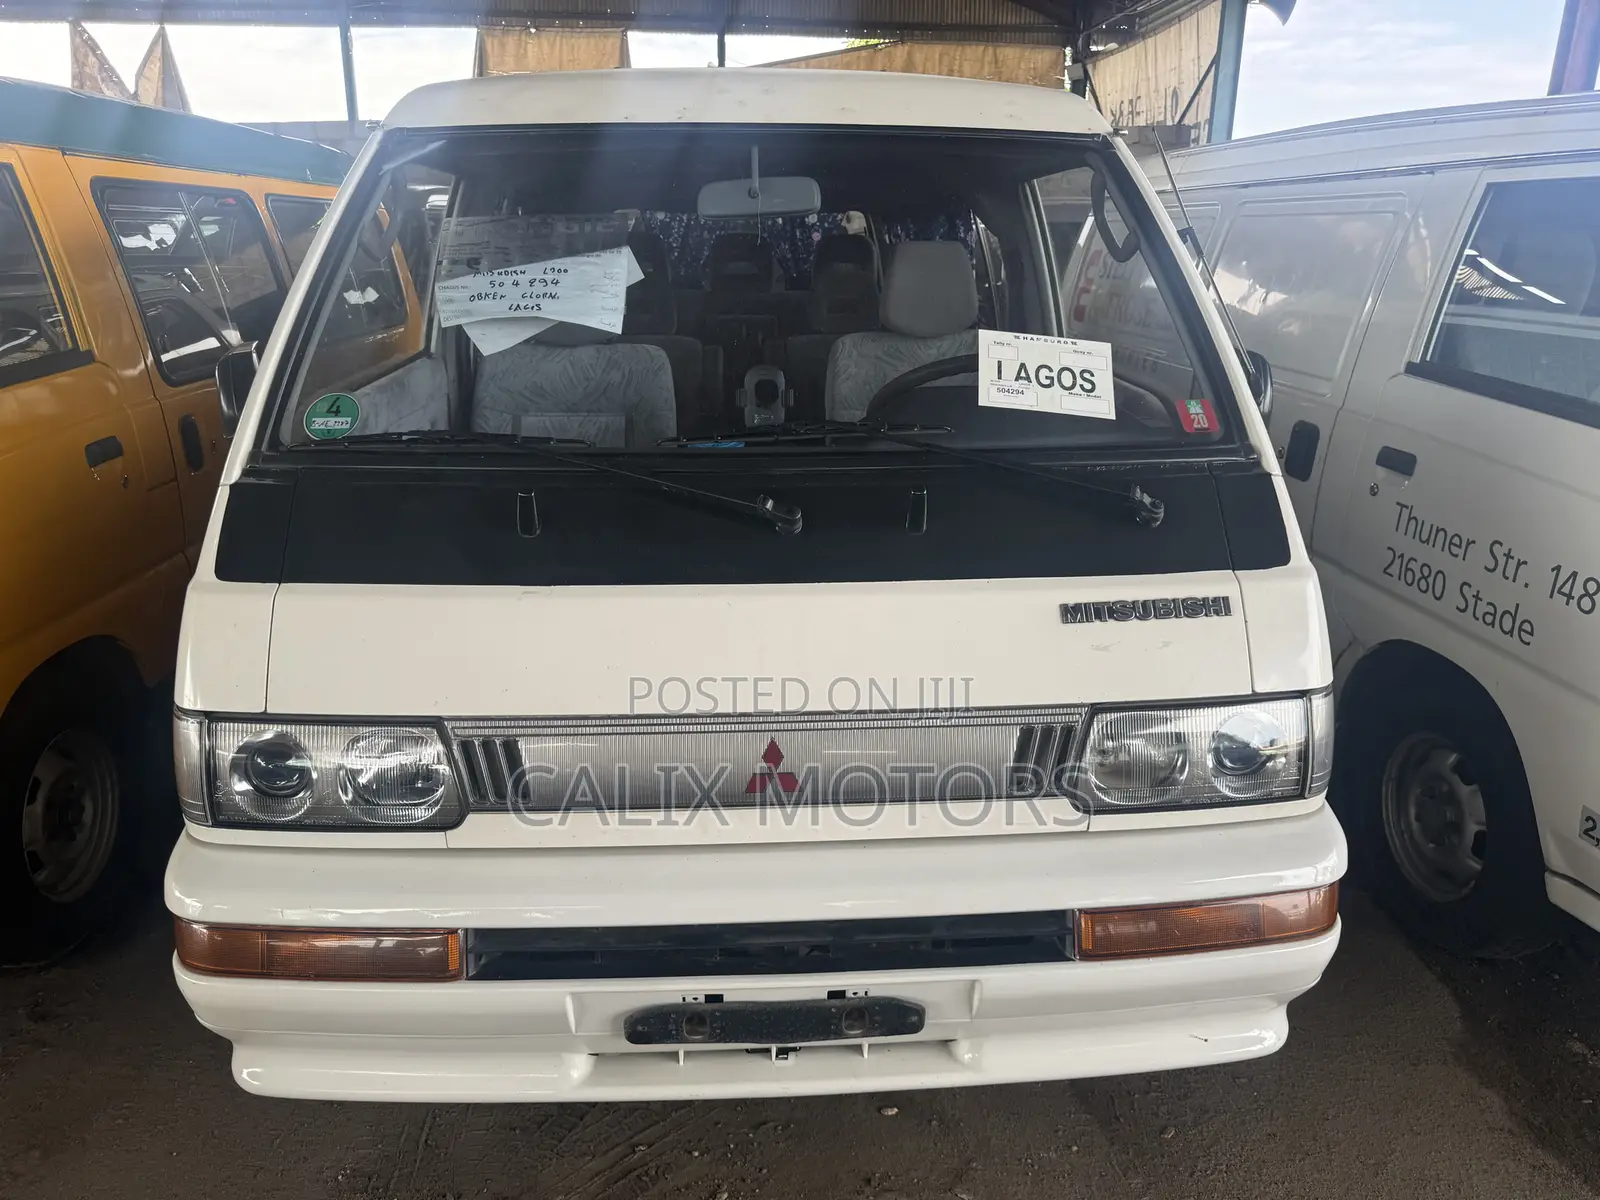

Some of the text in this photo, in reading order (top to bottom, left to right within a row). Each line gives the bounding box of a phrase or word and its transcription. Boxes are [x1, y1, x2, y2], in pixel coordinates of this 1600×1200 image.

[326, 397, 342, 416] 4
[1190, 414, 1209, 428] 20
[1394, 501, 1600, 616] Thuner Str. 148
[1059, 596, 1233, 624] MITSUBISHI
[1382, 546, 1535, 647] 21680 Stade
